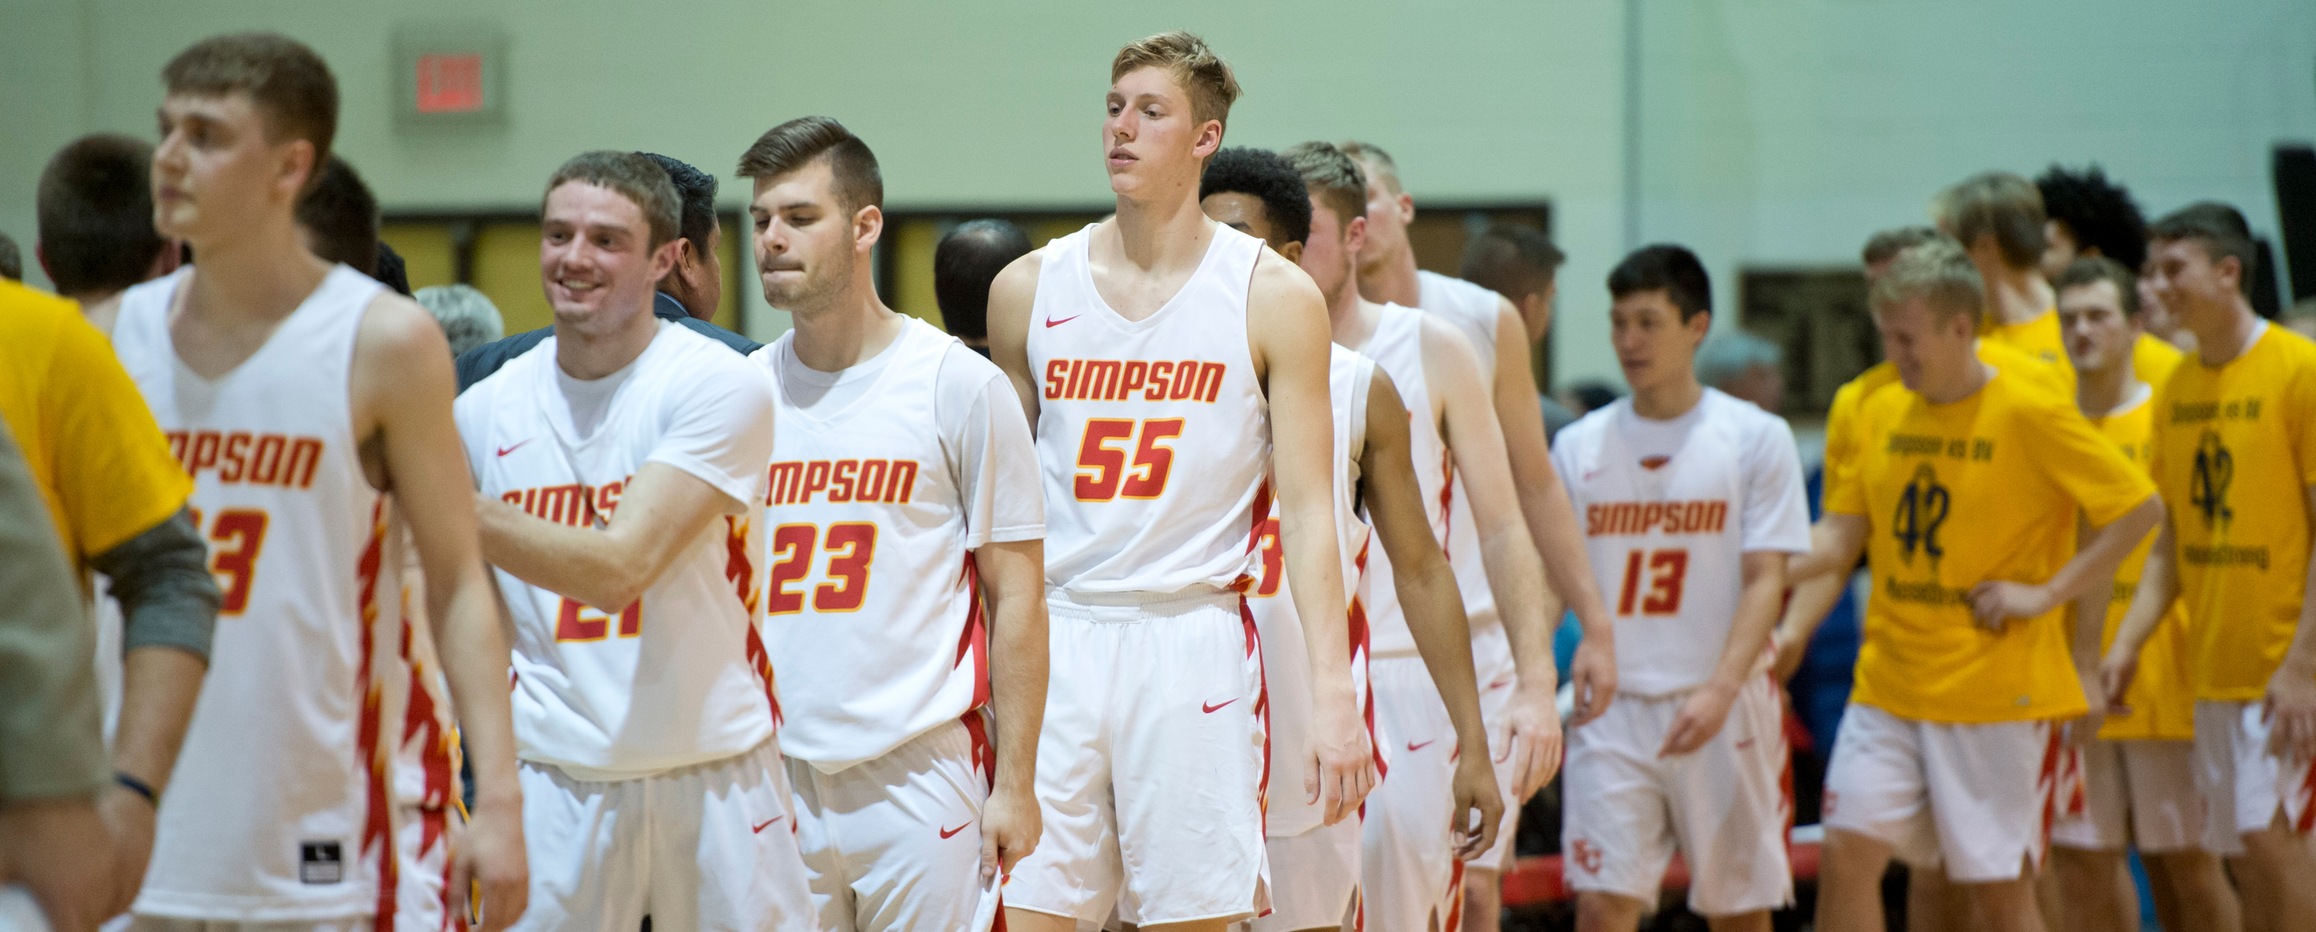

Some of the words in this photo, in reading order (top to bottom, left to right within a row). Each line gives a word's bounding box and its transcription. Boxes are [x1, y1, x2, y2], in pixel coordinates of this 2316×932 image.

[1045, 358, 1226, 403] SIMPSON
[165, 429, 323, 490] PSON
[766, 458, 918, 507] MPSON
[1073, 417, 1186, 503] 55
[1585, 499, 1728, 539] SIMPSON
[1893, 481, 1951, 557] 42
[767, 521, 879, 617] 23
[1615, 547, 1690, 619] 13
